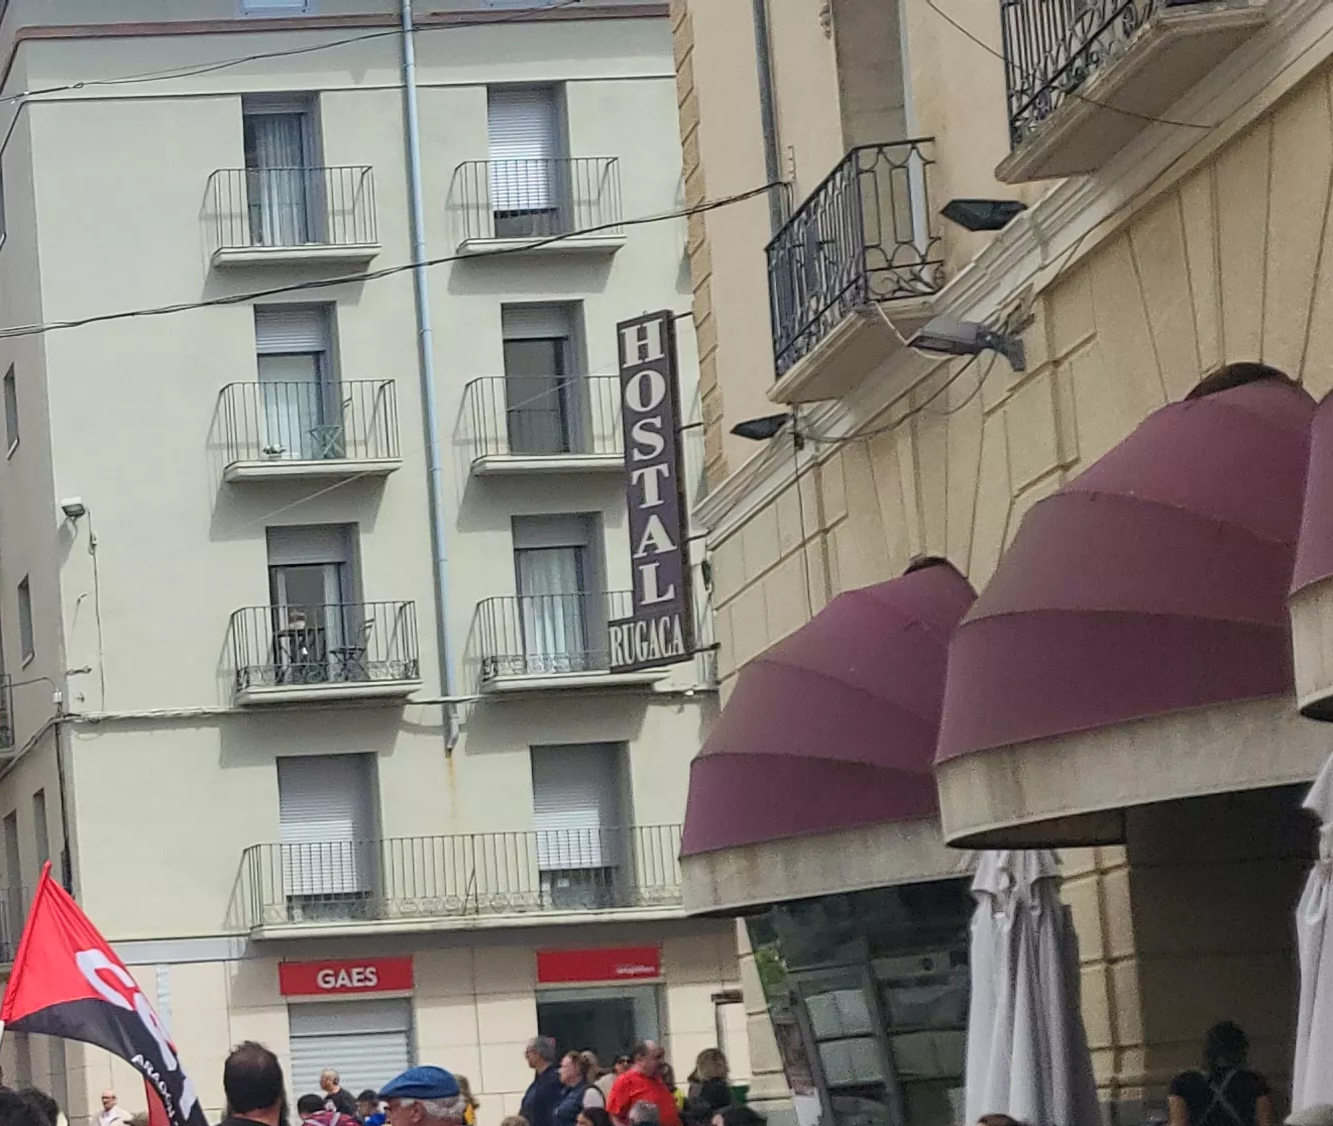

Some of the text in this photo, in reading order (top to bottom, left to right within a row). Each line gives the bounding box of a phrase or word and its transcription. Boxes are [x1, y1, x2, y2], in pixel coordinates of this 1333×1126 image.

[619, 319, 677, 606] HOSTAL
[610, 614, 683, 667] RUGACA
[316, 967, 378, 989] GAES
